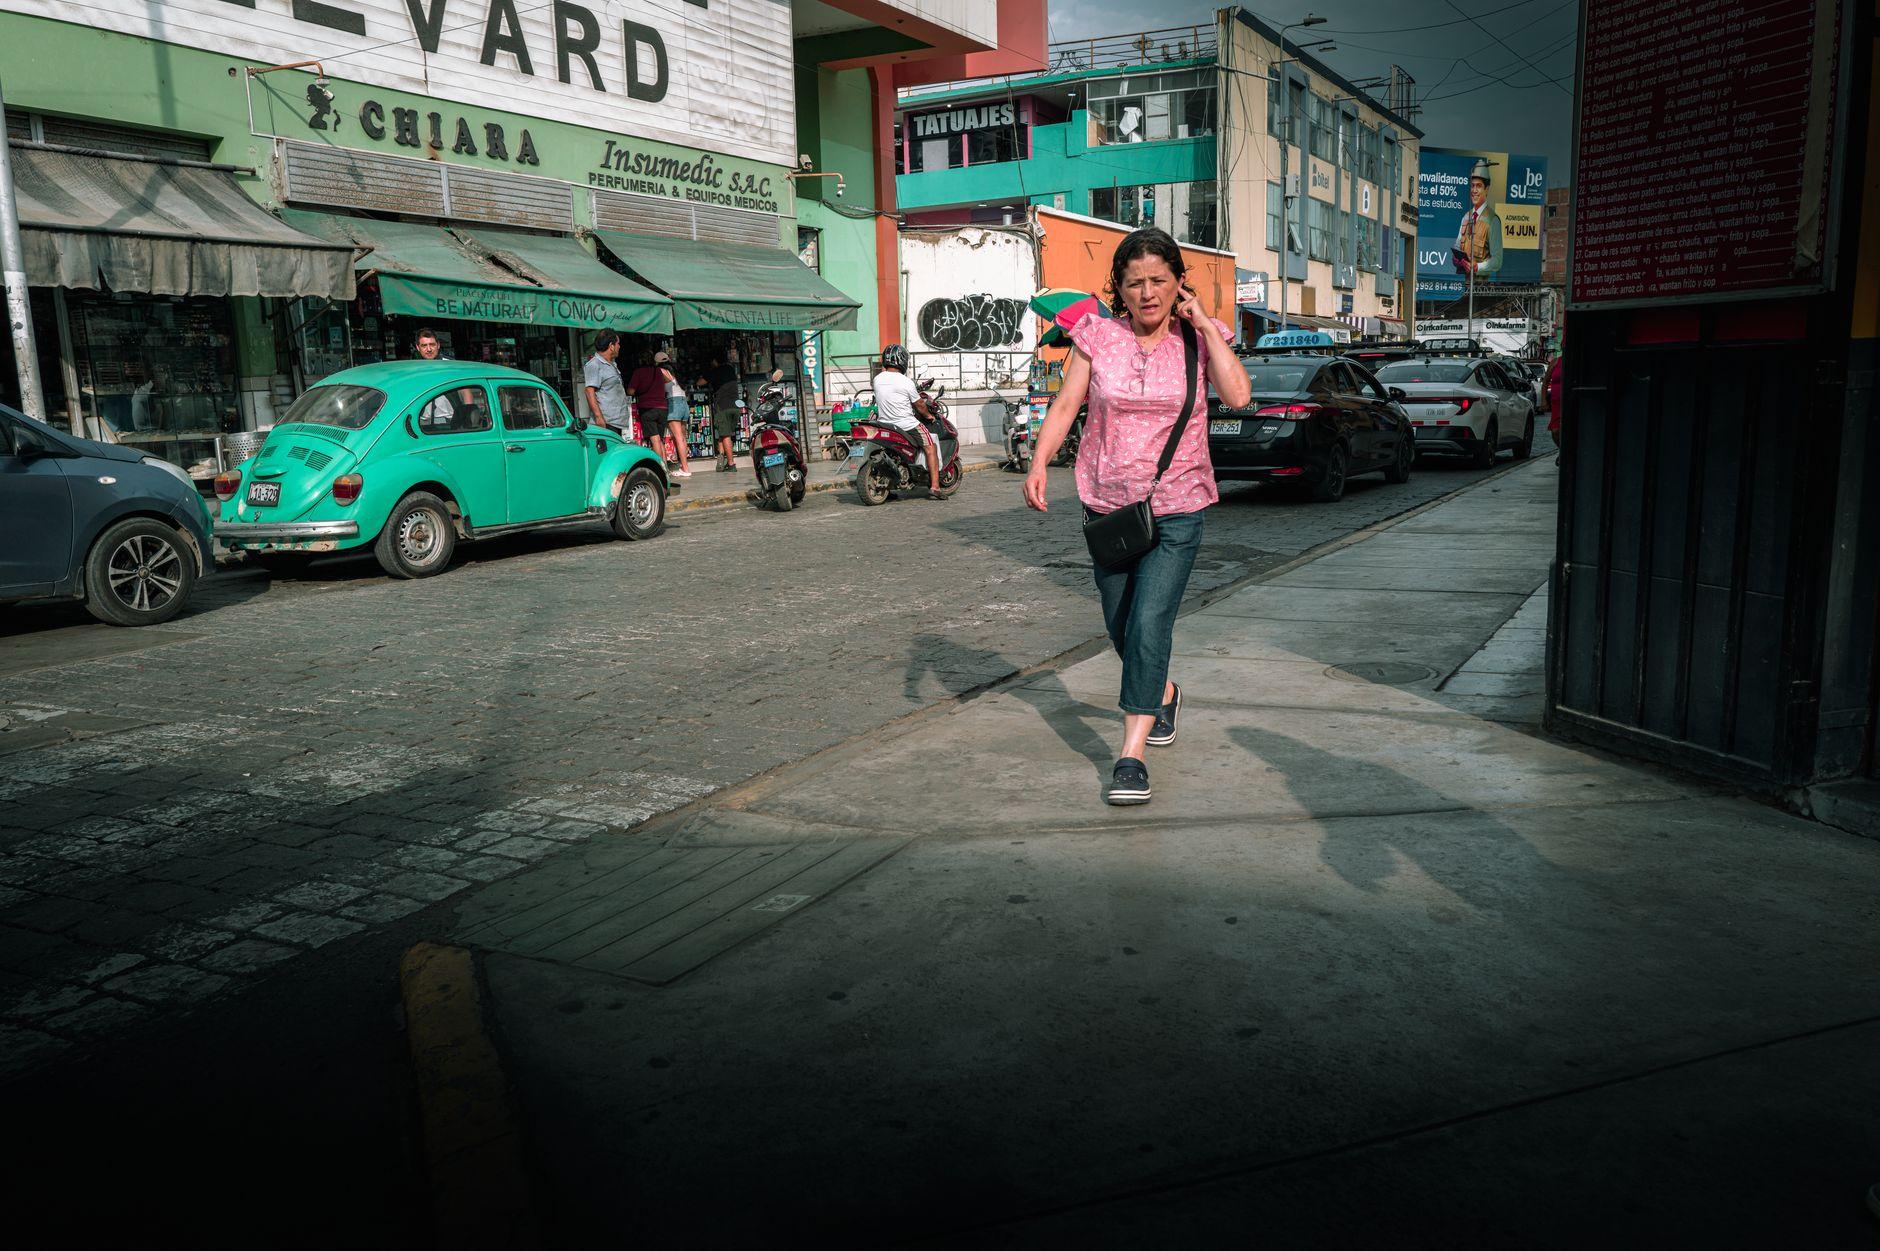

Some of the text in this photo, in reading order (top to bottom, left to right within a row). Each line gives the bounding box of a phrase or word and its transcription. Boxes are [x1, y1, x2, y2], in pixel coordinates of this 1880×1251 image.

[913, 103, 1015, 137] TATUAJES
[359, 99, 540, 165] CHIARA
[600, 140, 773, 197] Insumedic S.A.C.
[589, 172, 778, 212] PERFUMERIA & EQUIPOS MEDICOS
[1430, 185, 1438, 195] el
[1439, 185, 1457, 197] 50%
[1505, 225, 1537, 237] 14 JUN.
[1419, 251, 1447, 265] UCV
[436, 298, 457, 315] BE
[698, 307, 767, 325] PLACENTA
[769, 309, 793, 325] LIFE
[1423, 322, 1463, 331] Inkafarma
[1273, 335, 1320, 346] 231840
